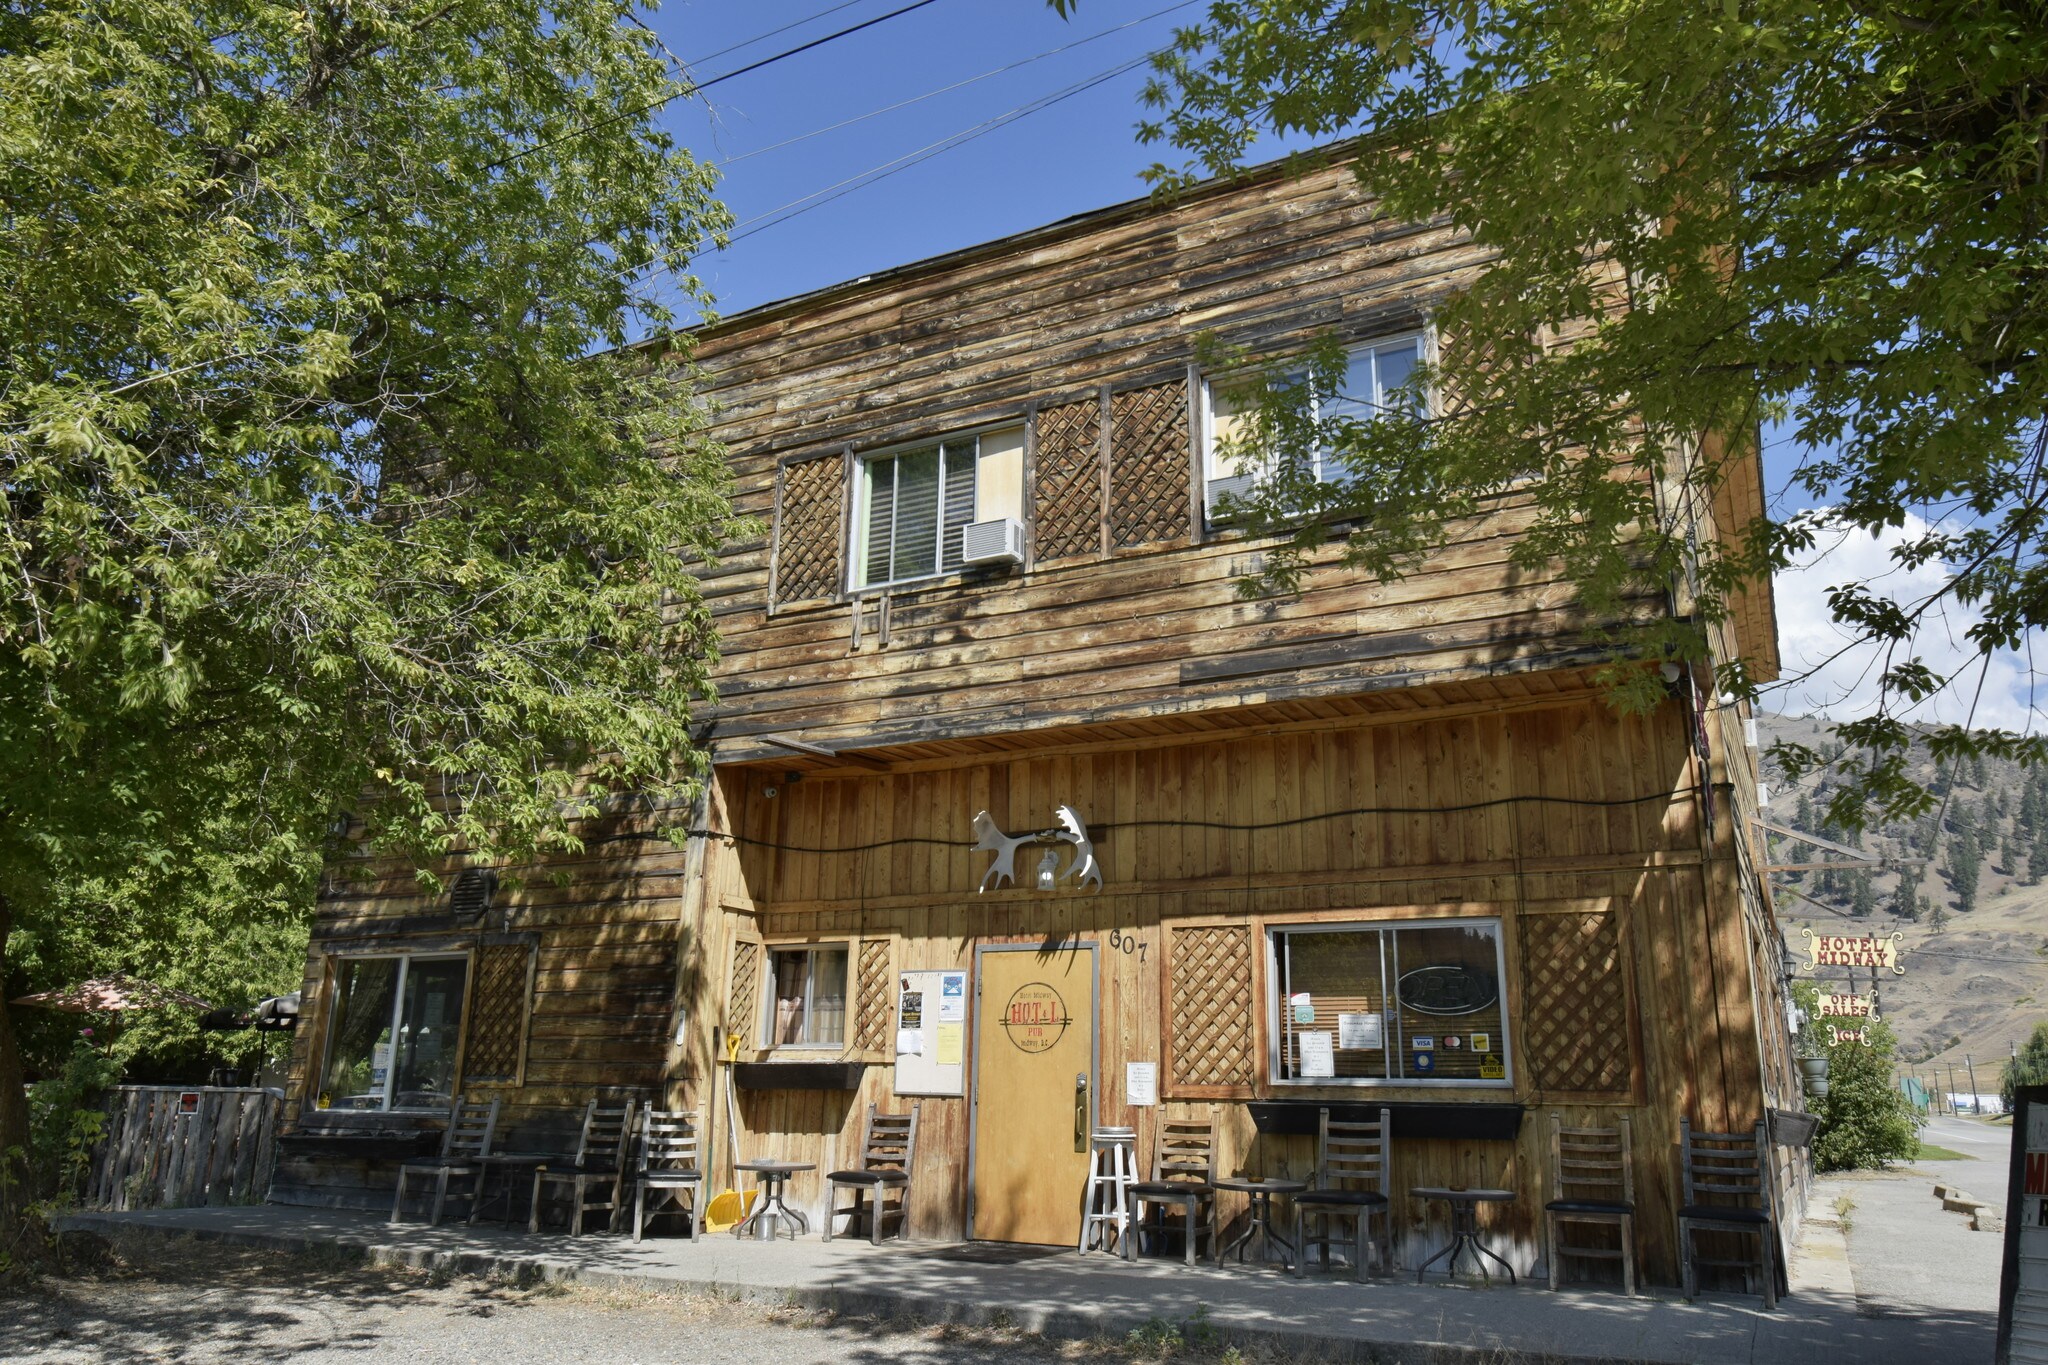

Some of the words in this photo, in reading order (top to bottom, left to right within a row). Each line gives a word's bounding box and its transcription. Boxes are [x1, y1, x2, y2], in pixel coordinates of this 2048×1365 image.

[1109, 928, 1148, 963] 607
[1819, 936, 1885, 952] HOTEL
[1817, 951, 1888, 967] MIDWAY
[1831, 994, 1858, 1005] OFF
[1822, 1005, 1869, 1017] SALES
[1028, 1027, 1043, 1037] PUB
[1836, 1030, 1861, 1041] ICE
